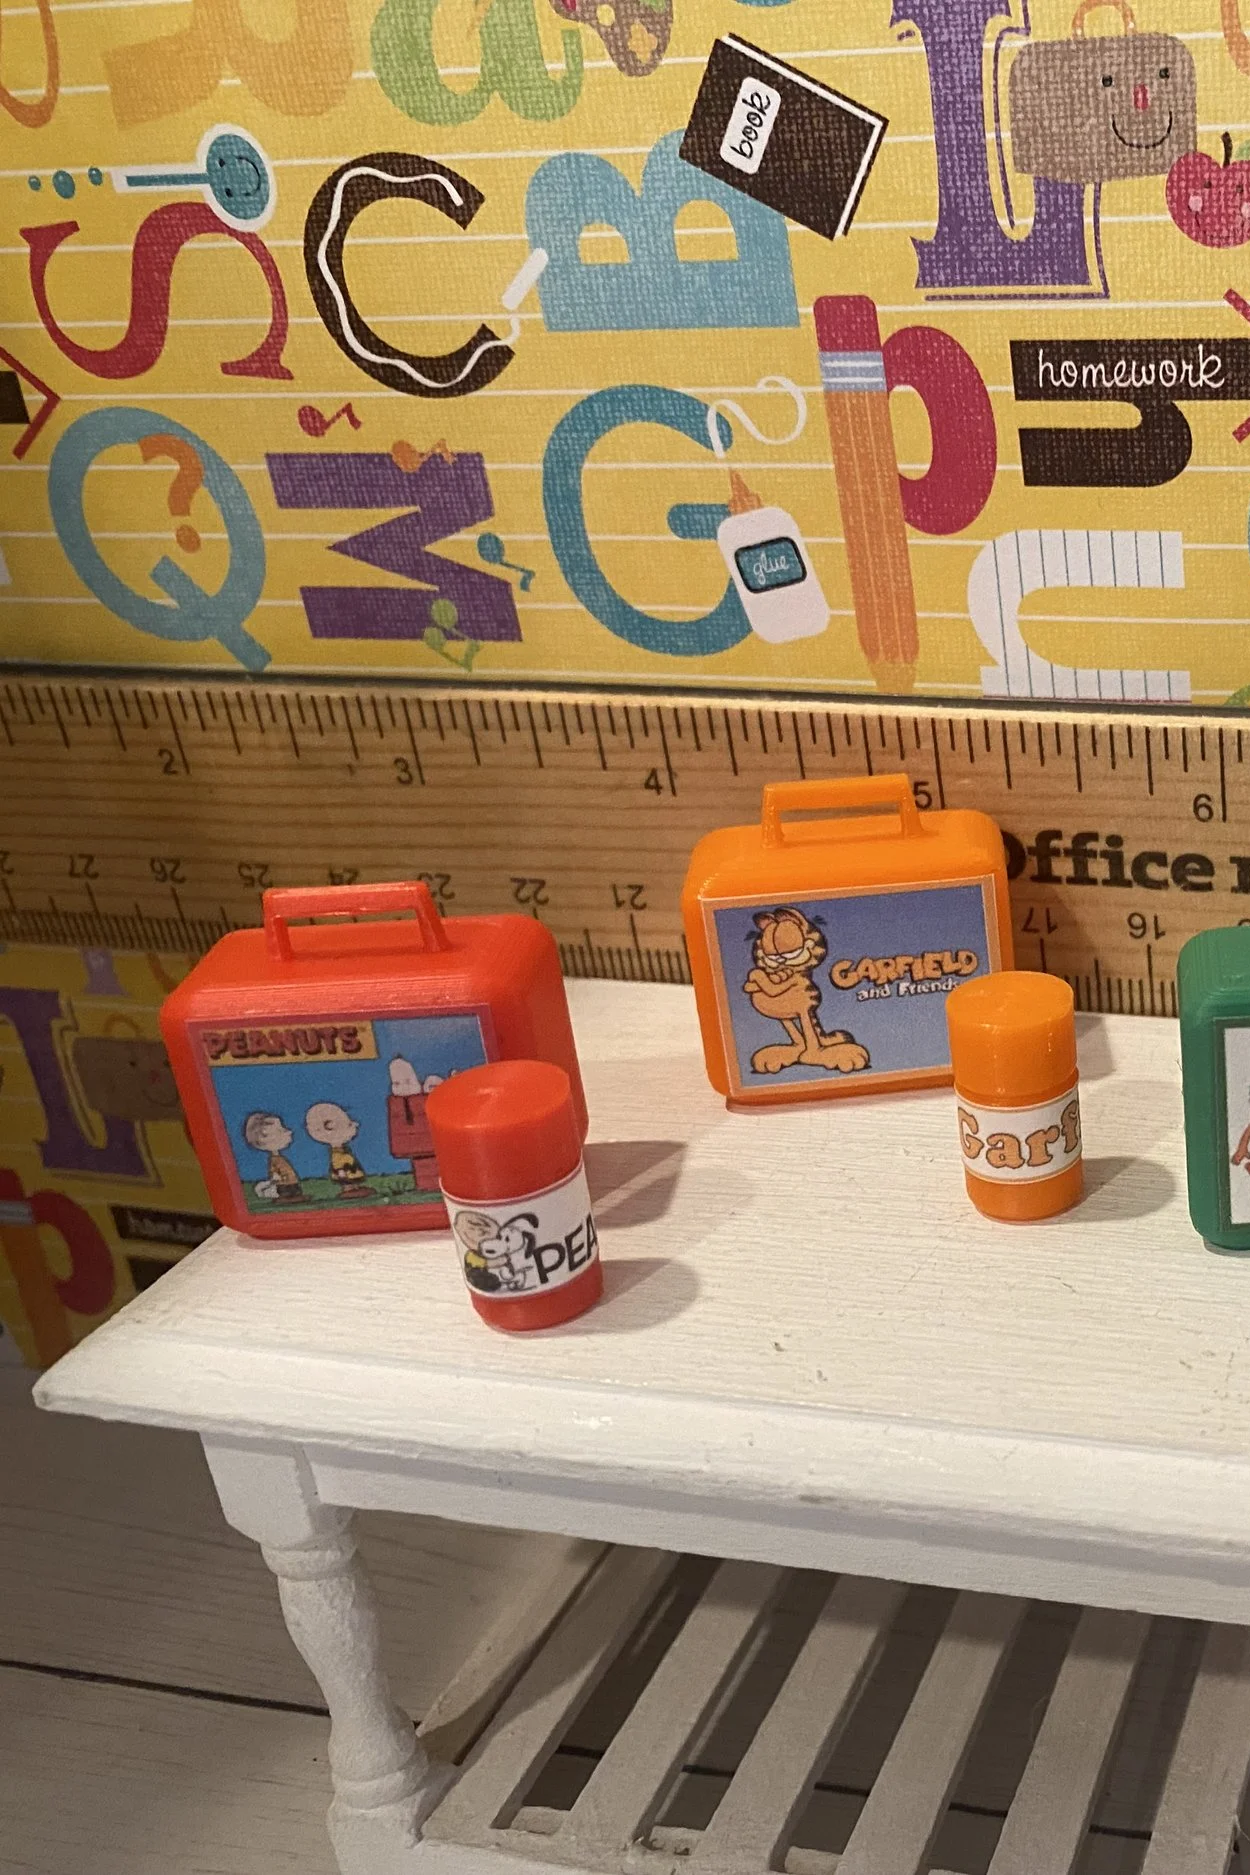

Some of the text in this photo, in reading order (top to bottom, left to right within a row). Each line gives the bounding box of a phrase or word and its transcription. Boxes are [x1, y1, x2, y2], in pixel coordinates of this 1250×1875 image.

[730, 91, 773, 159] book
[304, 152, 516, 399] C
[1037, 349, 1226, 389] homework
[48, 406, 272, 673] Q
[753, 549, 793, 582] glue
[157, 749, 178, 775] 2
[394, 757, 413, 785] 3
[644, 767, 663, 795] 4
[913, 781, 932, 809] 5
[1193, 793, 1214, 822] 6
[510, 877, 549, 906] 22
[612, 883, 647, 911] 21
[1021, 907, 1058, 935] 17
[1127, 912, 1166, 940] 16
[829, 950, 978, 990] GARFIELD
[857, 984, 891, 1001] and
[203, 1027, 363, 1060] PEANUTS
[958, 1099, 1080, 1169] Garf
